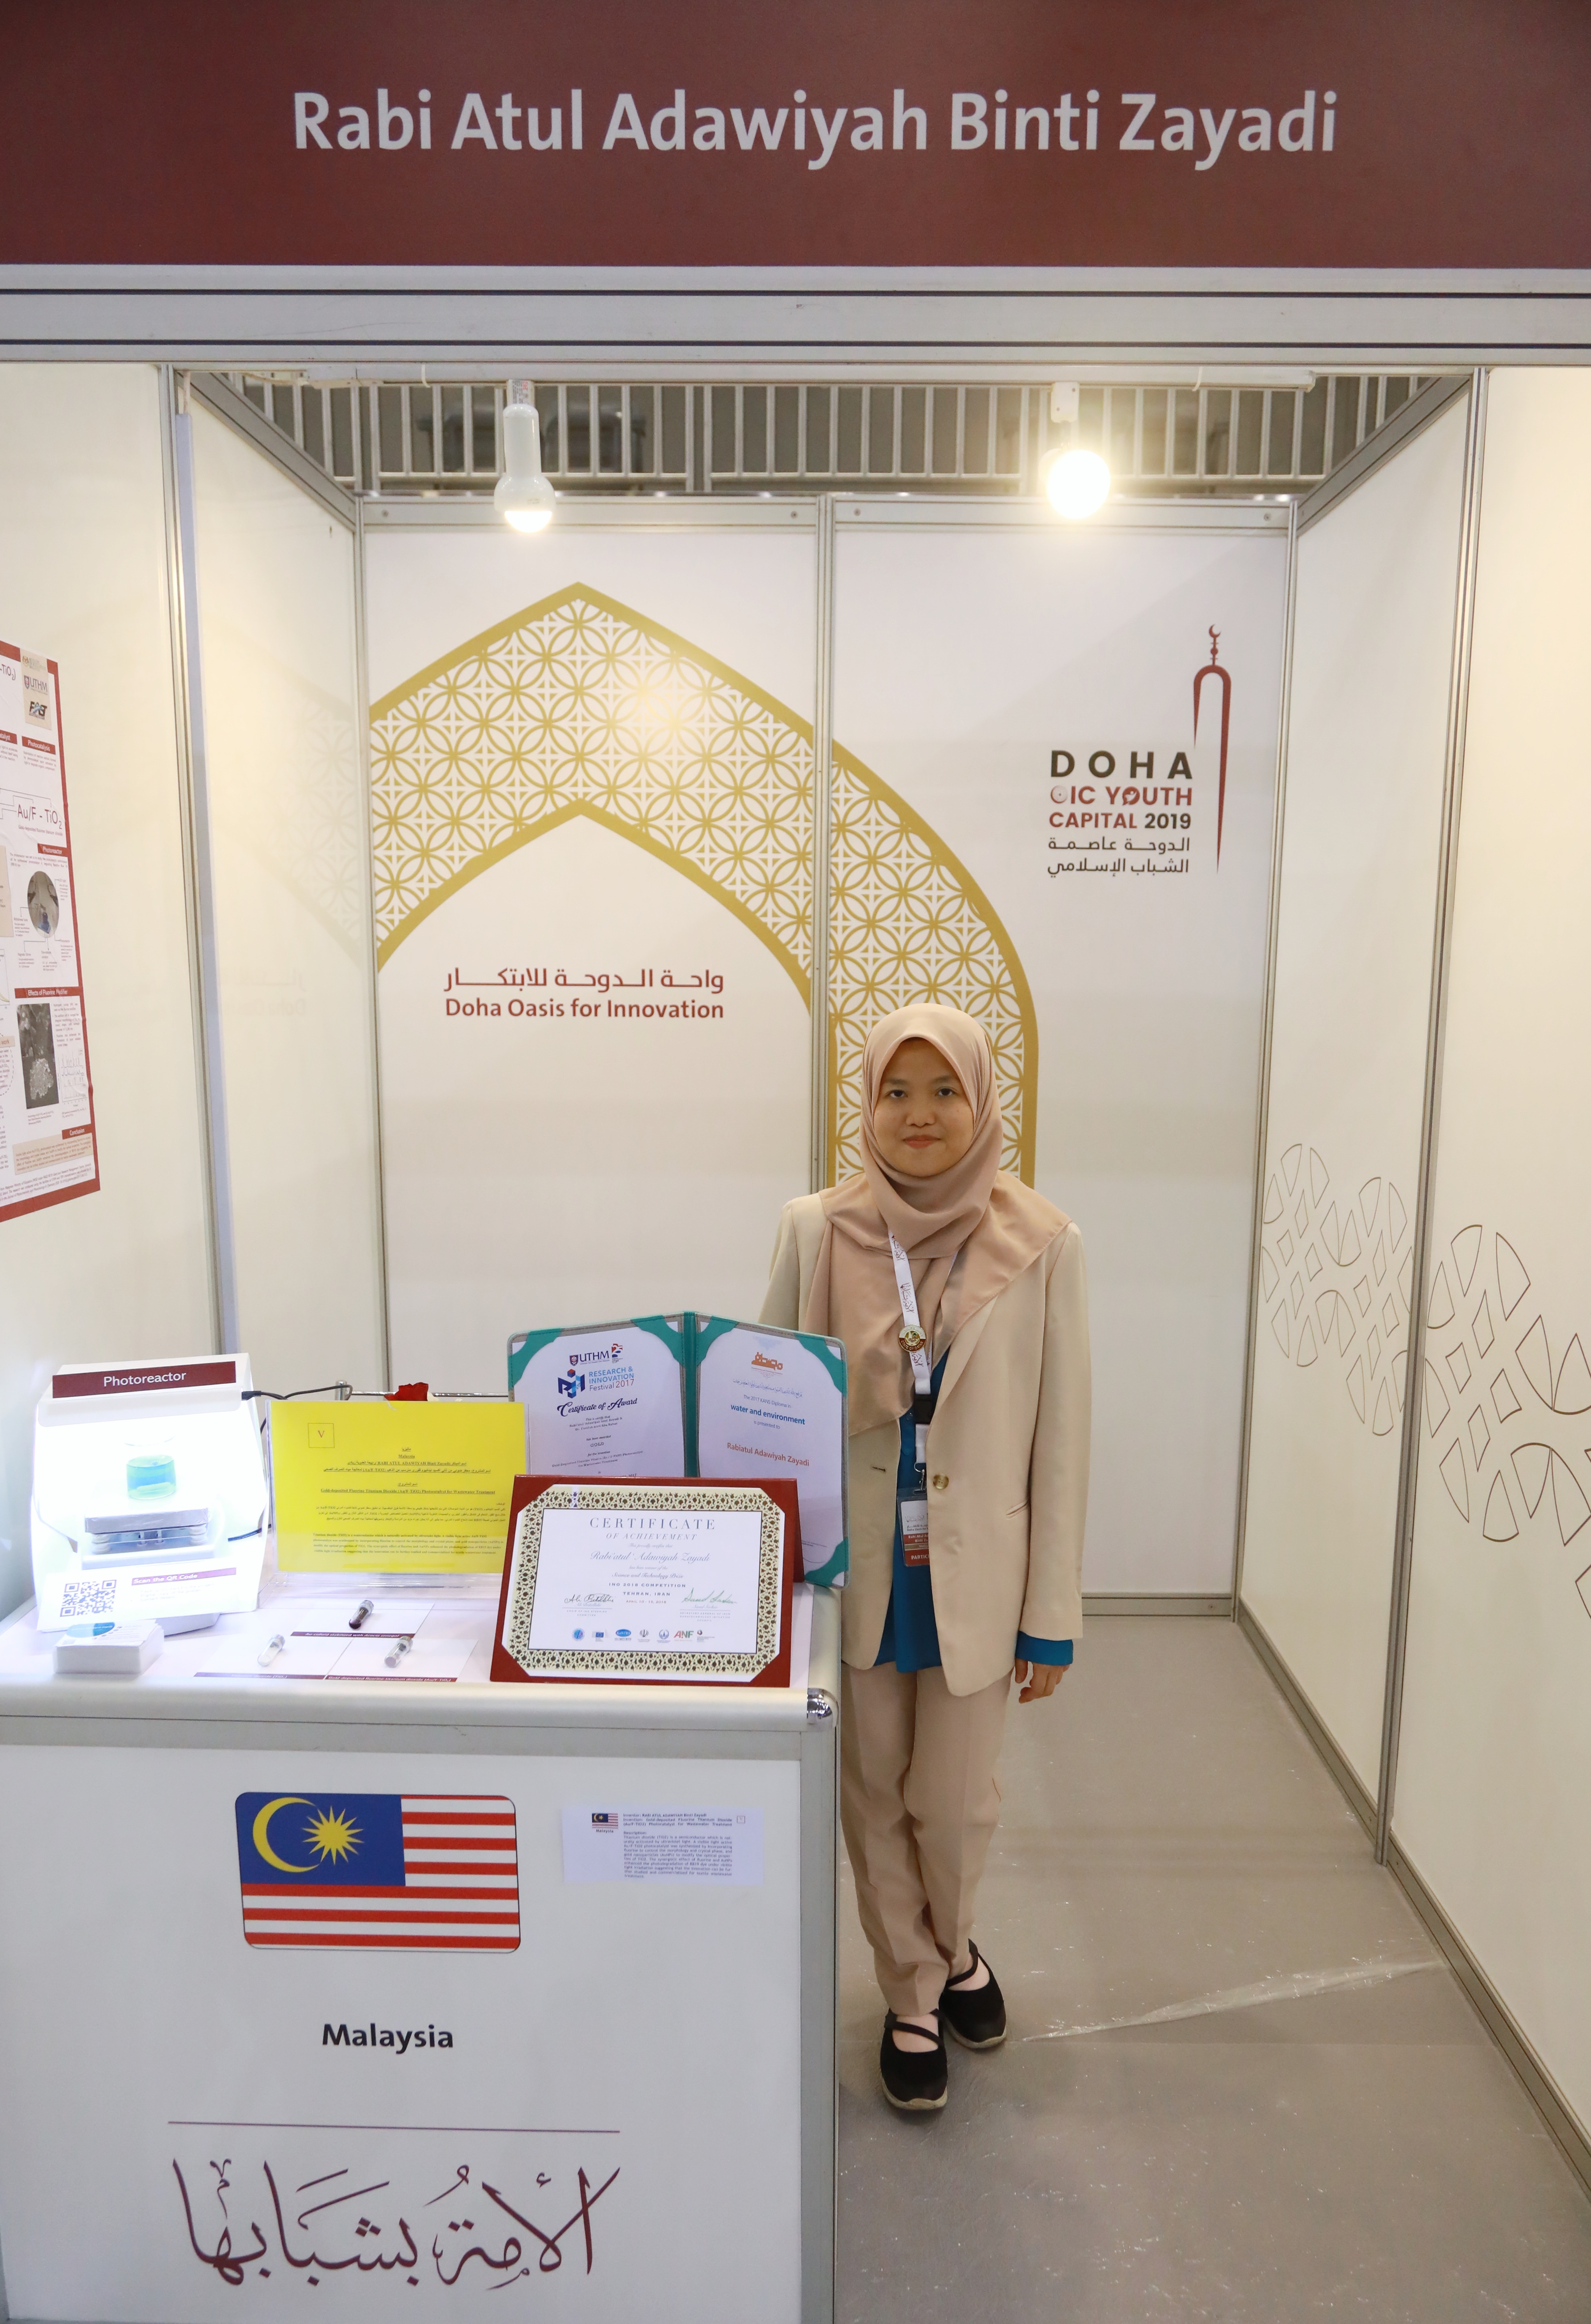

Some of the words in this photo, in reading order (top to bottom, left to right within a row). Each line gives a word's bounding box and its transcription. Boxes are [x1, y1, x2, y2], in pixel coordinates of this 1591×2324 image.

[293, 90, 433, 150] Rabi
[451, 90, 583, 150] Atul
[602, 90, 928, 170] Adawiyah
[950, 90, 1099, 151] Binti
[1119, 90, 1338, 172] Zayadi
[28, 739, 50, 752] Photocatalysis
[1050, 750, 1193, 779] DOHA
[1106, 786, 1192, 806] YOUTH
[18, 804, 36, 821] Au/F
[1049, 812, 1137, 828] CAPITAL
[1145, 812, 1191, 829] 2019
[42, 846, 62, 854] Photoreactor
[1048, 836, 1117, 851] عاصمة
[1124, 837, 1190, 854] الدوحة
[1047, 858, 1126, 877] الإسلامي
[1131, 859, 1189, 876] الشباب
[444, 967, 547, 992] للابتكار
[554, 968, 653, 993] الدوحة
[660, 969, 724, 994] واحة
[445, 998, 501, 1016] Doha
[507, 998, 565, 1017] Oasis
[571, 998, 601, 1017] for
[607, 999, 724, 1018] Innovation
[69, 1128, 85, 1136] Conclusion
[900, 1340, 909, 1349] STATE
[914, 1340, 924, 1349] QATAR
[580, 1350, 610, 1362] UTHM
[103, 1371, 187, 1388] Photoreactor
[589, 1367, 626, 1377] RESEARCH
[589, 1373, 634, 1384] INNOVATION
[589, 1382, 614, 1391] Festival
[615, 1378, 634, 1388] 2017
[557, 1401, 597, 1417] Certificate
[598, 1402, 605, 1411] of
[607, 1397, 638, 1411] Award
[771, 1399, 787, 1408] Diploma
[730, 1404, 748, 1413] water
[749, 1408, 762, 1416] and
[763, 1411, 805, 1425] environment
[727, 1442, 753, 1454] Rabiatul
[754, 1448, 786, 1462] Adawiyah
[787, 1456, 810, 1466] Zayadi
[590, 1517, 715, 1530] CERTIFICATE
[681, 1552, 711, 1564] Zayadi
[322, 2023, 454, 2054] Malaysia
